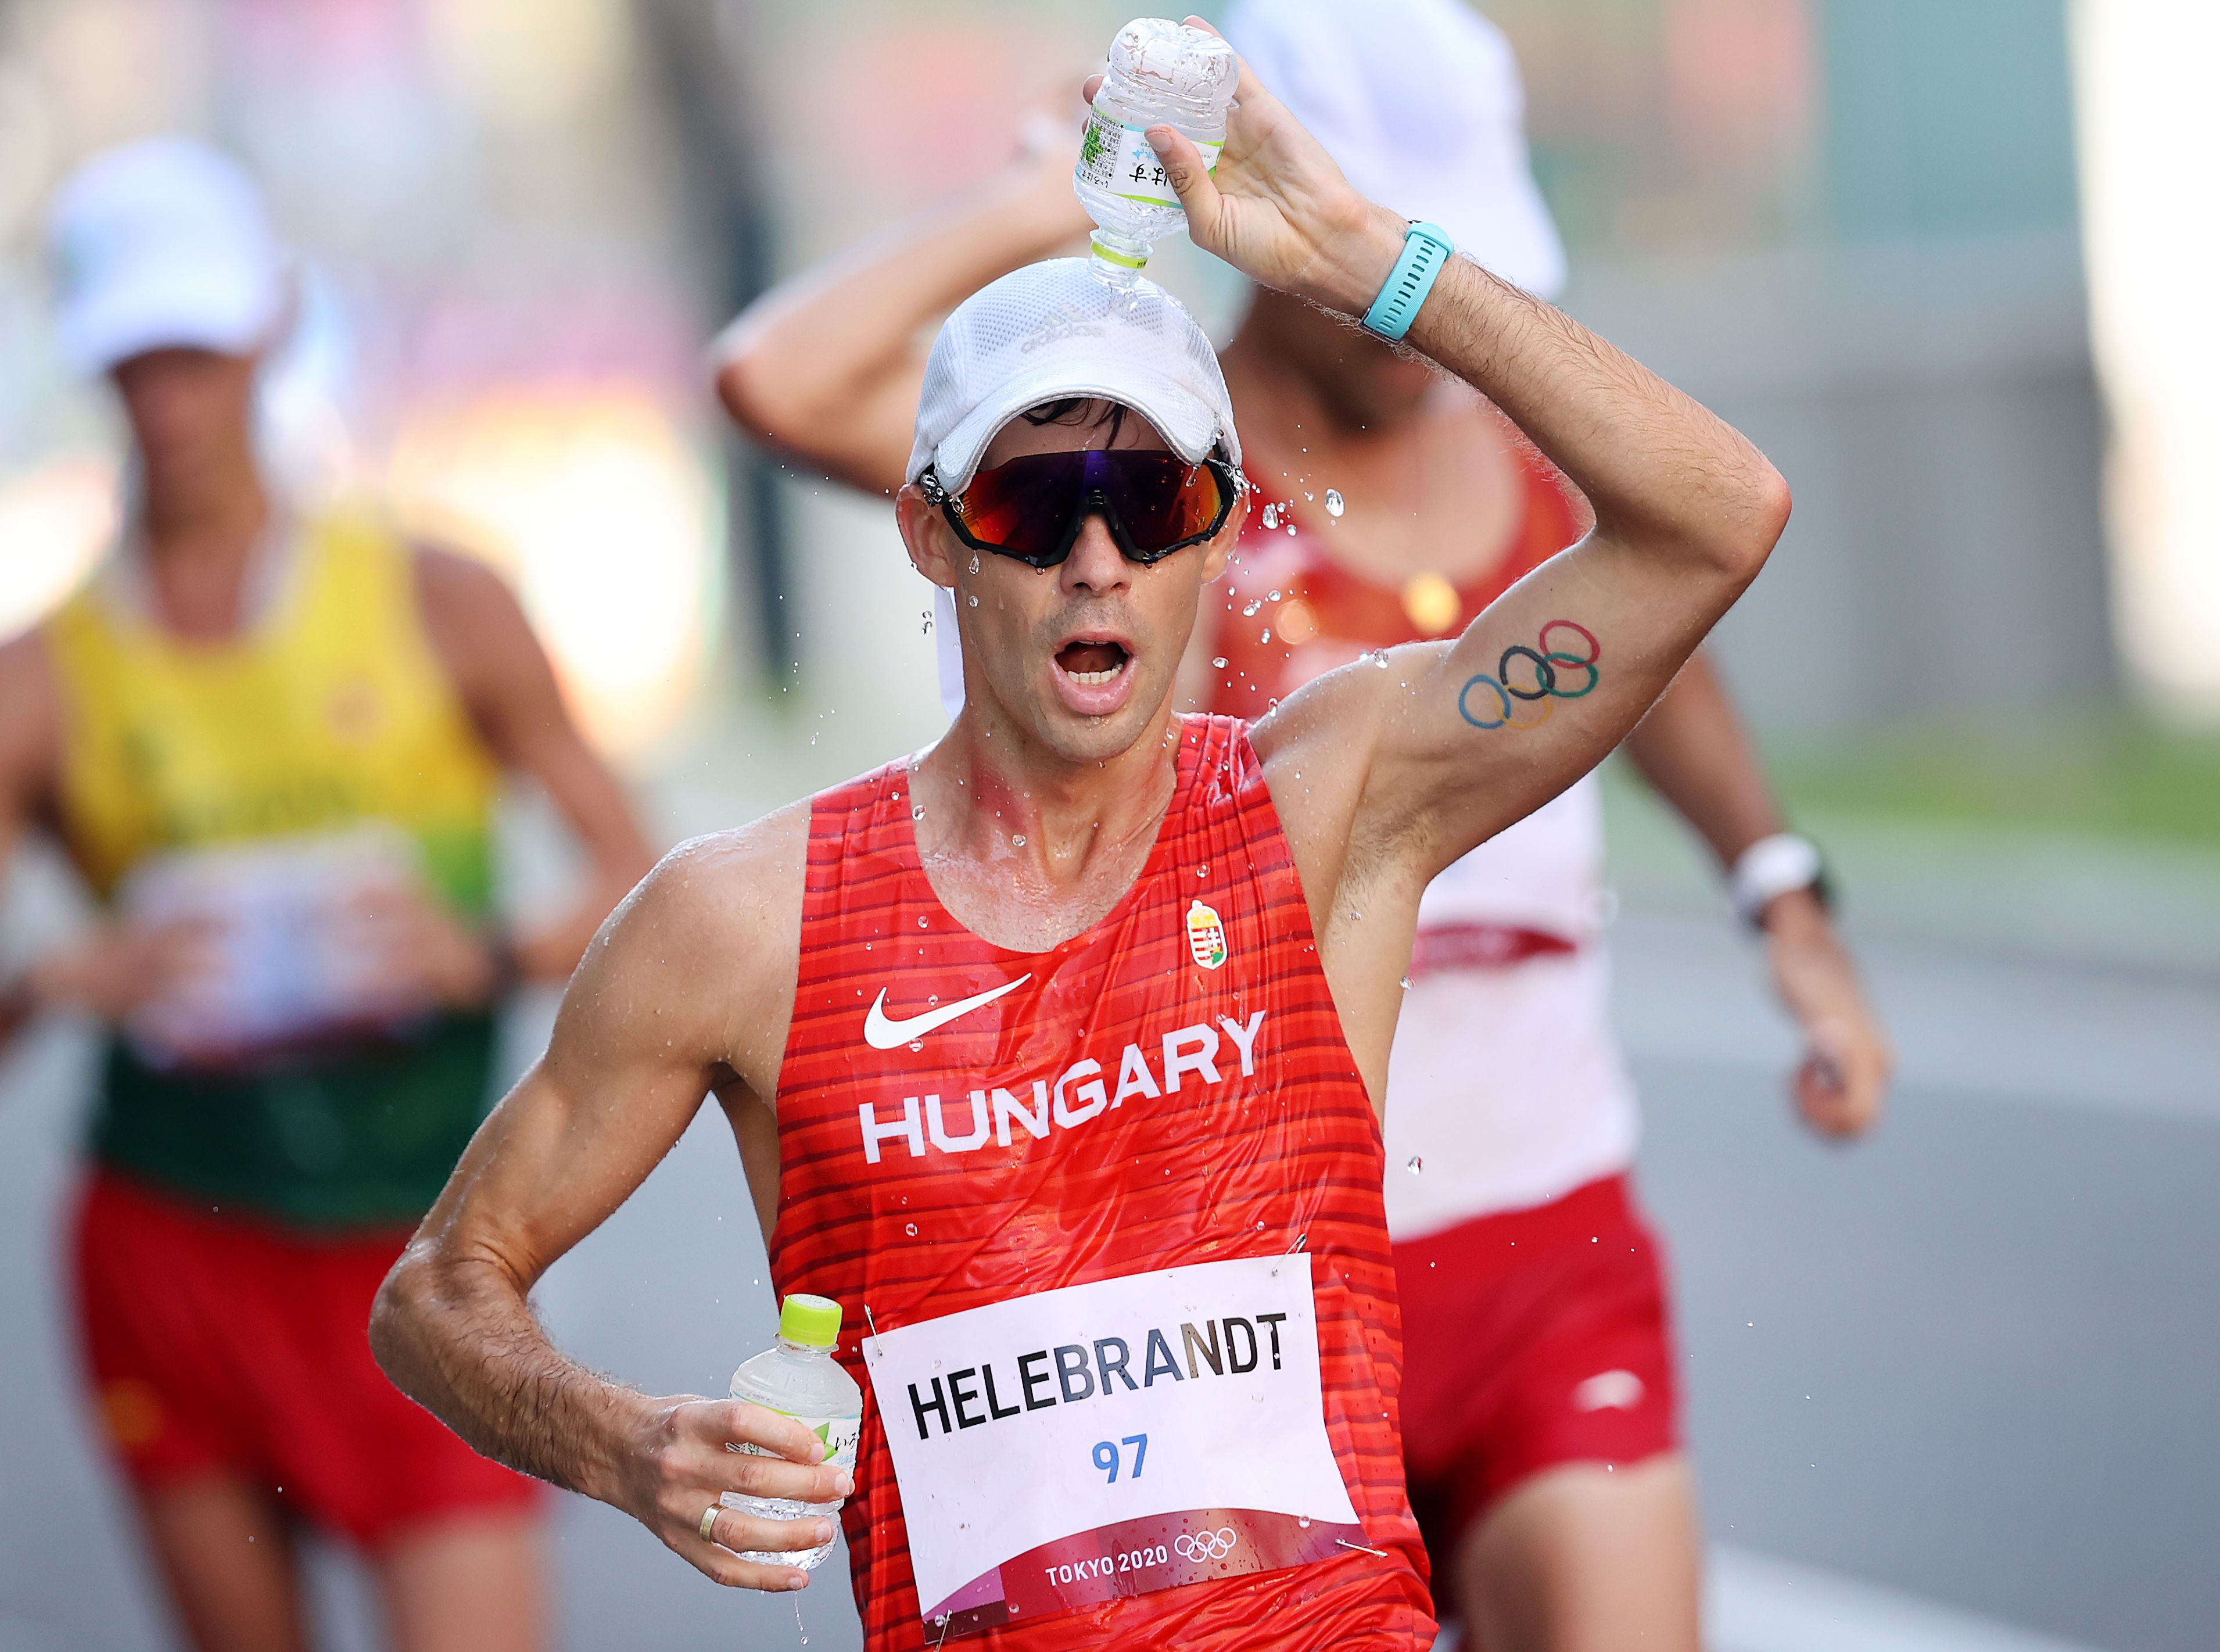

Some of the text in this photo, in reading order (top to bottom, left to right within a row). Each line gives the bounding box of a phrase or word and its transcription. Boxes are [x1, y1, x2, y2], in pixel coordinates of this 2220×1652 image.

[858, 1010, 1267, 1164] HUNGARY
[908, 1313, 1286, 1440] HELEBRANDT
[1092, 1433, 1148, 1483] 97
[1045, 1545, 1168, 1586] TOKYO 2020
